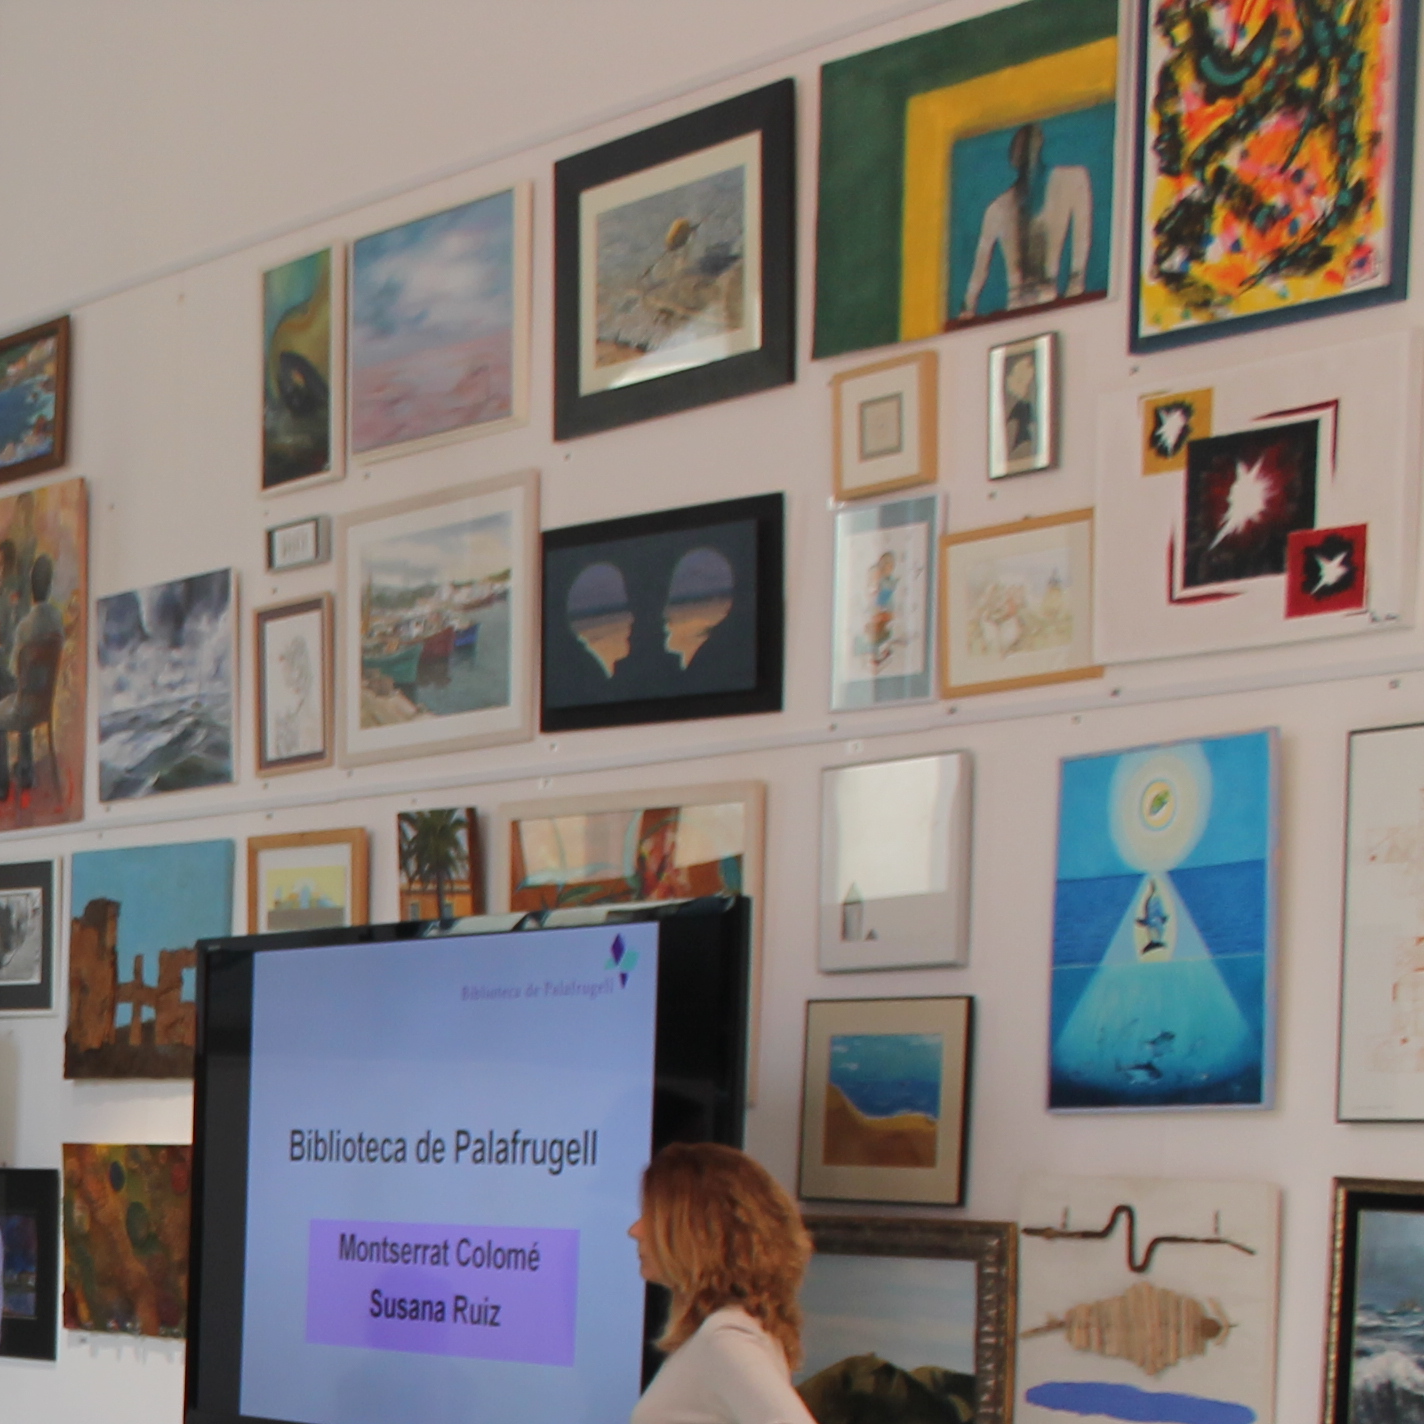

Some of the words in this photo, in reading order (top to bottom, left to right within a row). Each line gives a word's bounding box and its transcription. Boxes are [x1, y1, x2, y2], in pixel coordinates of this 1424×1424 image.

[290, 1128, 407, 1163] Biblioteca
[415, 1129, 446, 1164] de
[454, 1129, 598, 1176] Palafrugell
[338, 1232, 450, 1268] Montserrat
[455, 1237, 541, 1272] Colomé
[369, 1287, 446, 1323] Susana
[452, 1294, 501, 1328] Ruiz
